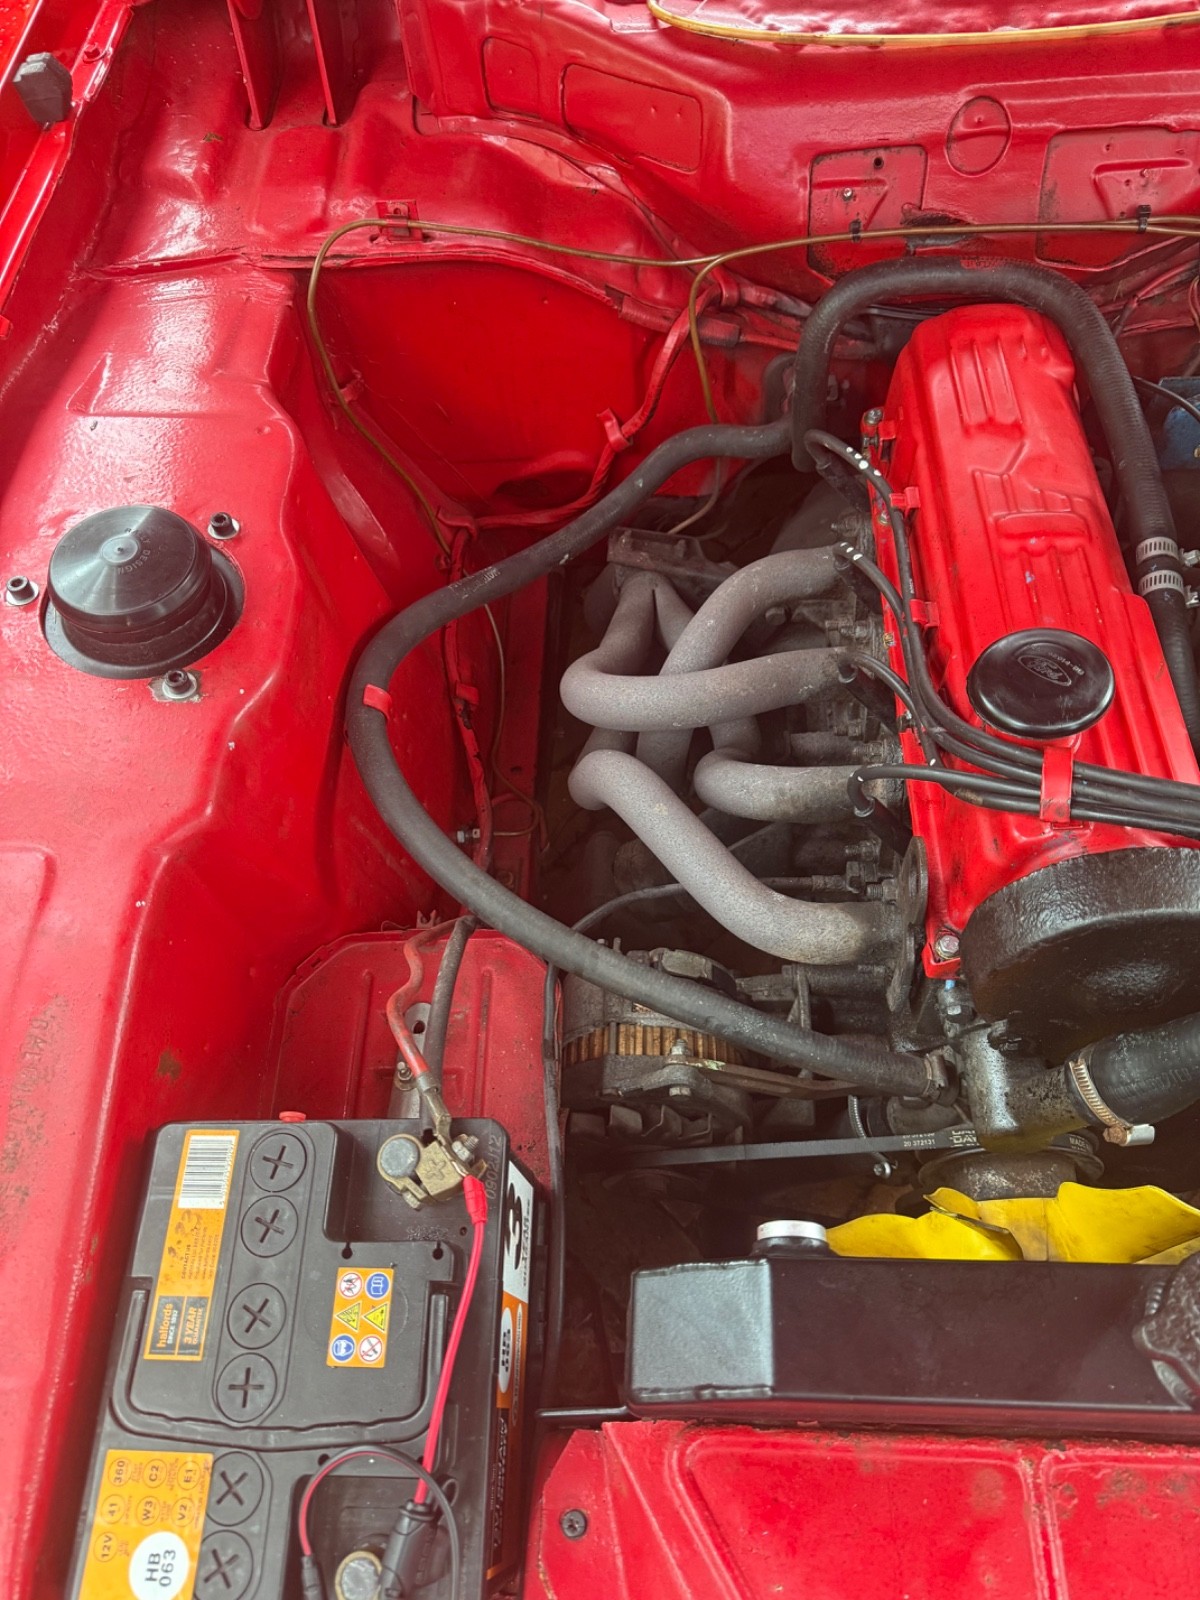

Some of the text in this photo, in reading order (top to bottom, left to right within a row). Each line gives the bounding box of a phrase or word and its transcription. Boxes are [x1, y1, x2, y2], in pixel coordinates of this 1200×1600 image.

[117, 549, 151, 575] DESIGN
[1027, 659, 1063, 680] Ford
[155, 1303, 173, 1347] halfords
[183, 1307, 197, 1344] 3 YEAR
[113, 1460, 125, 1483] 360
[148, 1465, 159, 1481] C2
[183, 1468, 193, 1482] E1
[107, 1503, 117, 1516] 41
[141, 1500, 153, 1520] W3
[177, 1504, 187, 1520] V2
[100, 1534, 112, 1557] 12V
[144, 1552, 161, 1581] HB
[158, 1549, 176, 1586] 063
